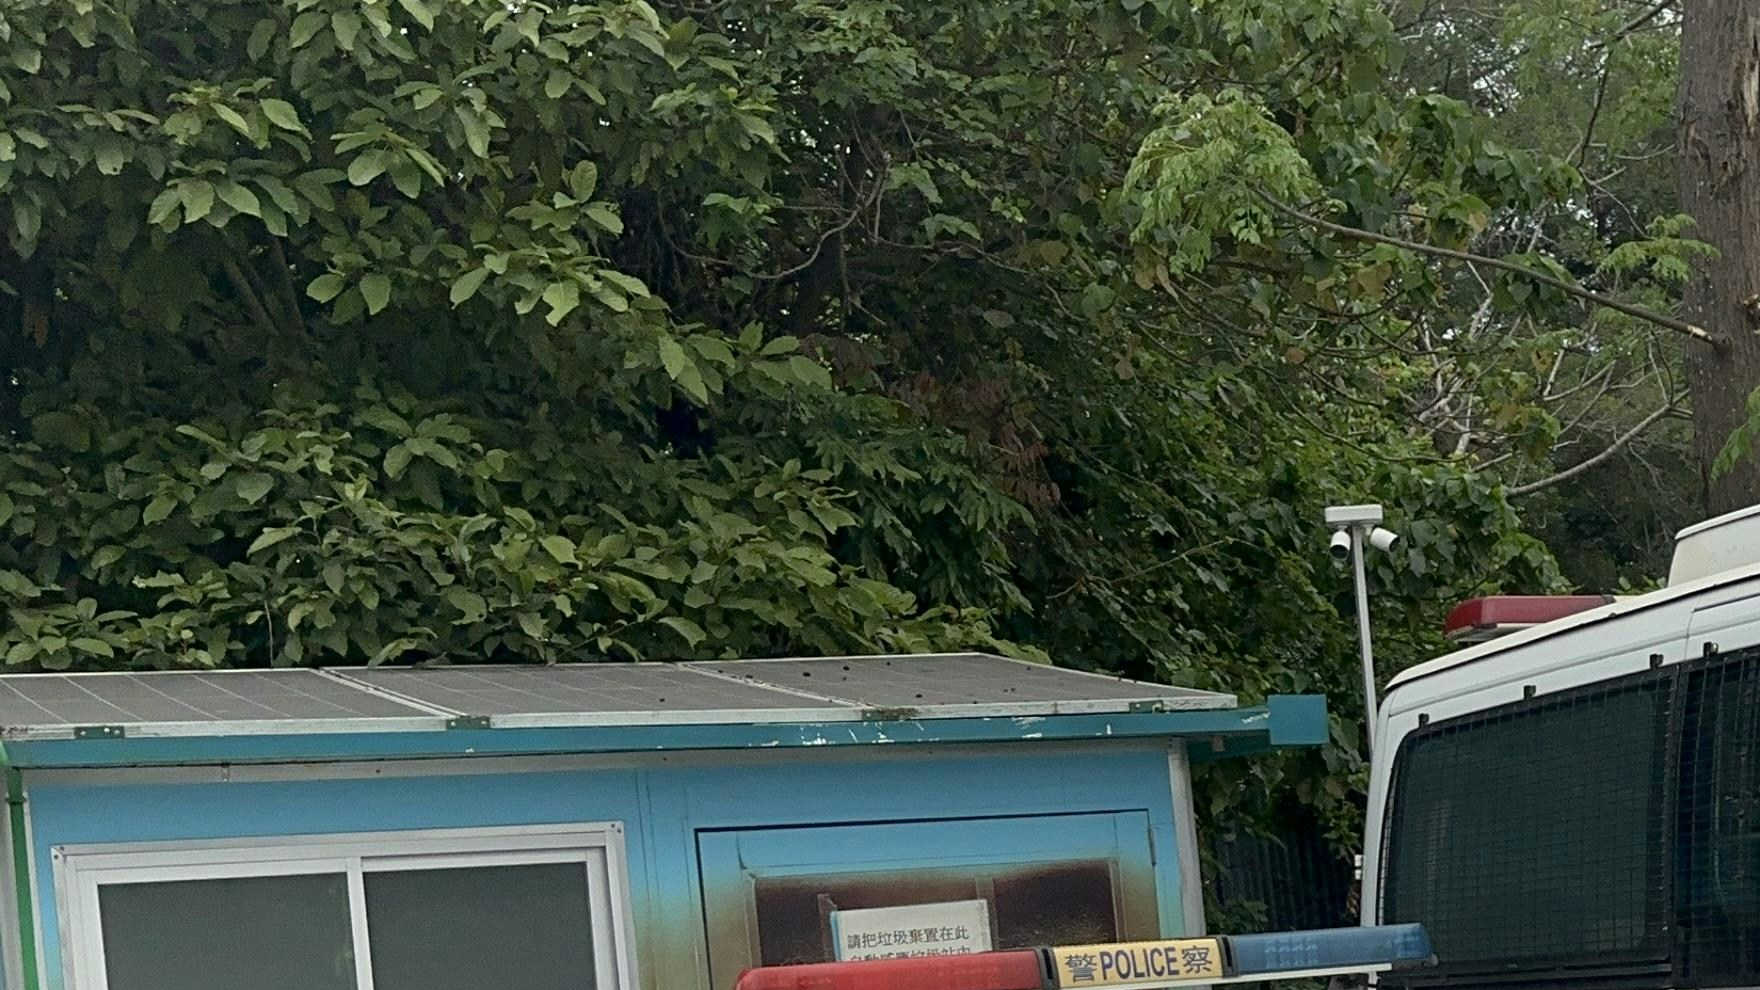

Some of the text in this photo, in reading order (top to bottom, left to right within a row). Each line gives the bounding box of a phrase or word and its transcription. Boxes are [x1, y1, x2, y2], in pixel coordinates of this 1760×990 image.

[847, 924, 969, 950] 請把垃圾棄置在此
